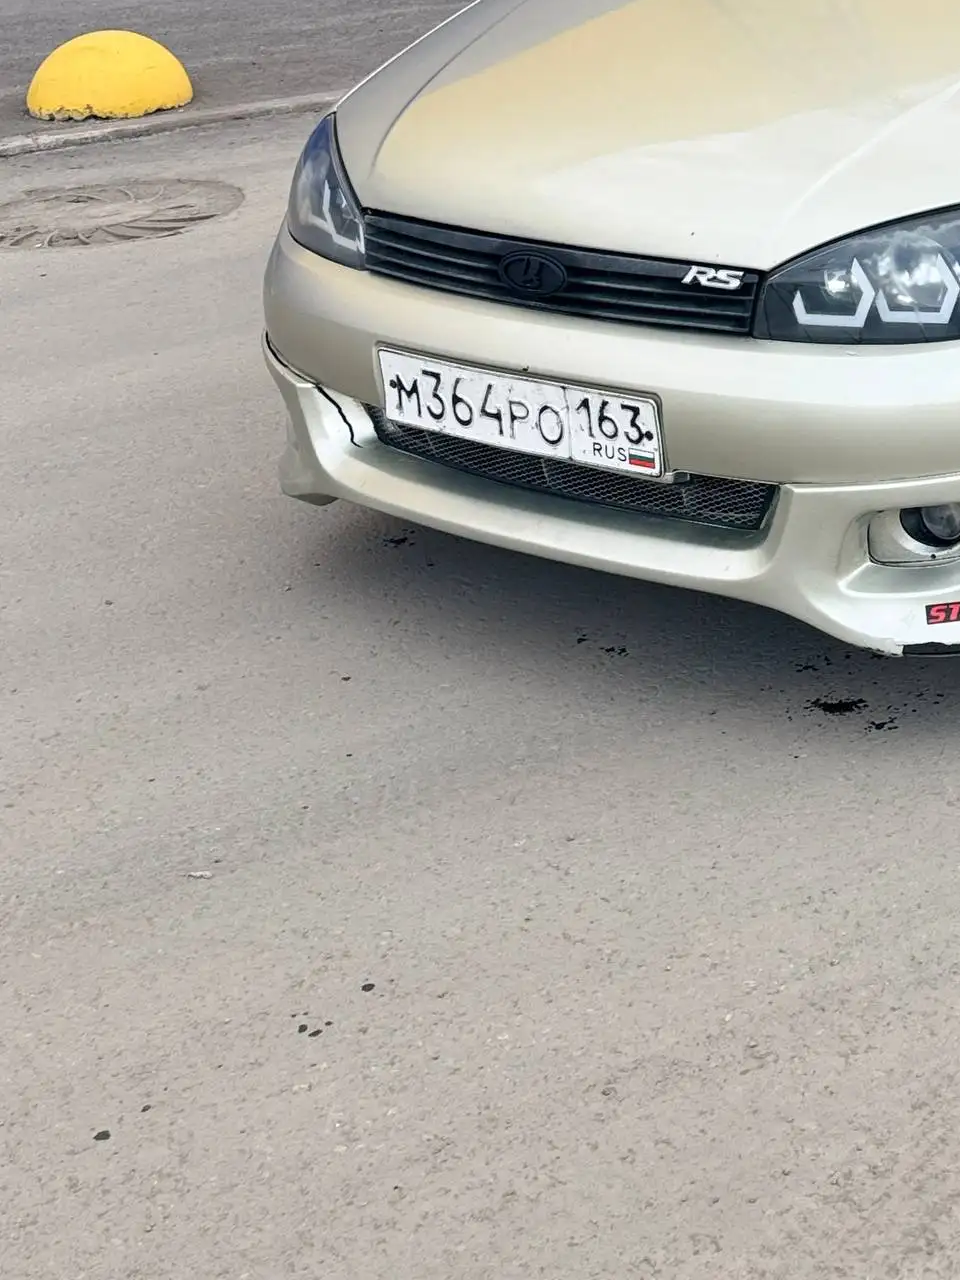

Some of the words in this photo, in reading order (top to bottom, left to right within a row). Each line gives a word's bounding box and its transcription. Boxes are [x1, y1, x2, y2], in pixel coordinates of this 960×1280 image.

[681, 265, 744, 290] RS
[576, 397, 644, 445] 163
[592, 443, 627, 462] RUS
